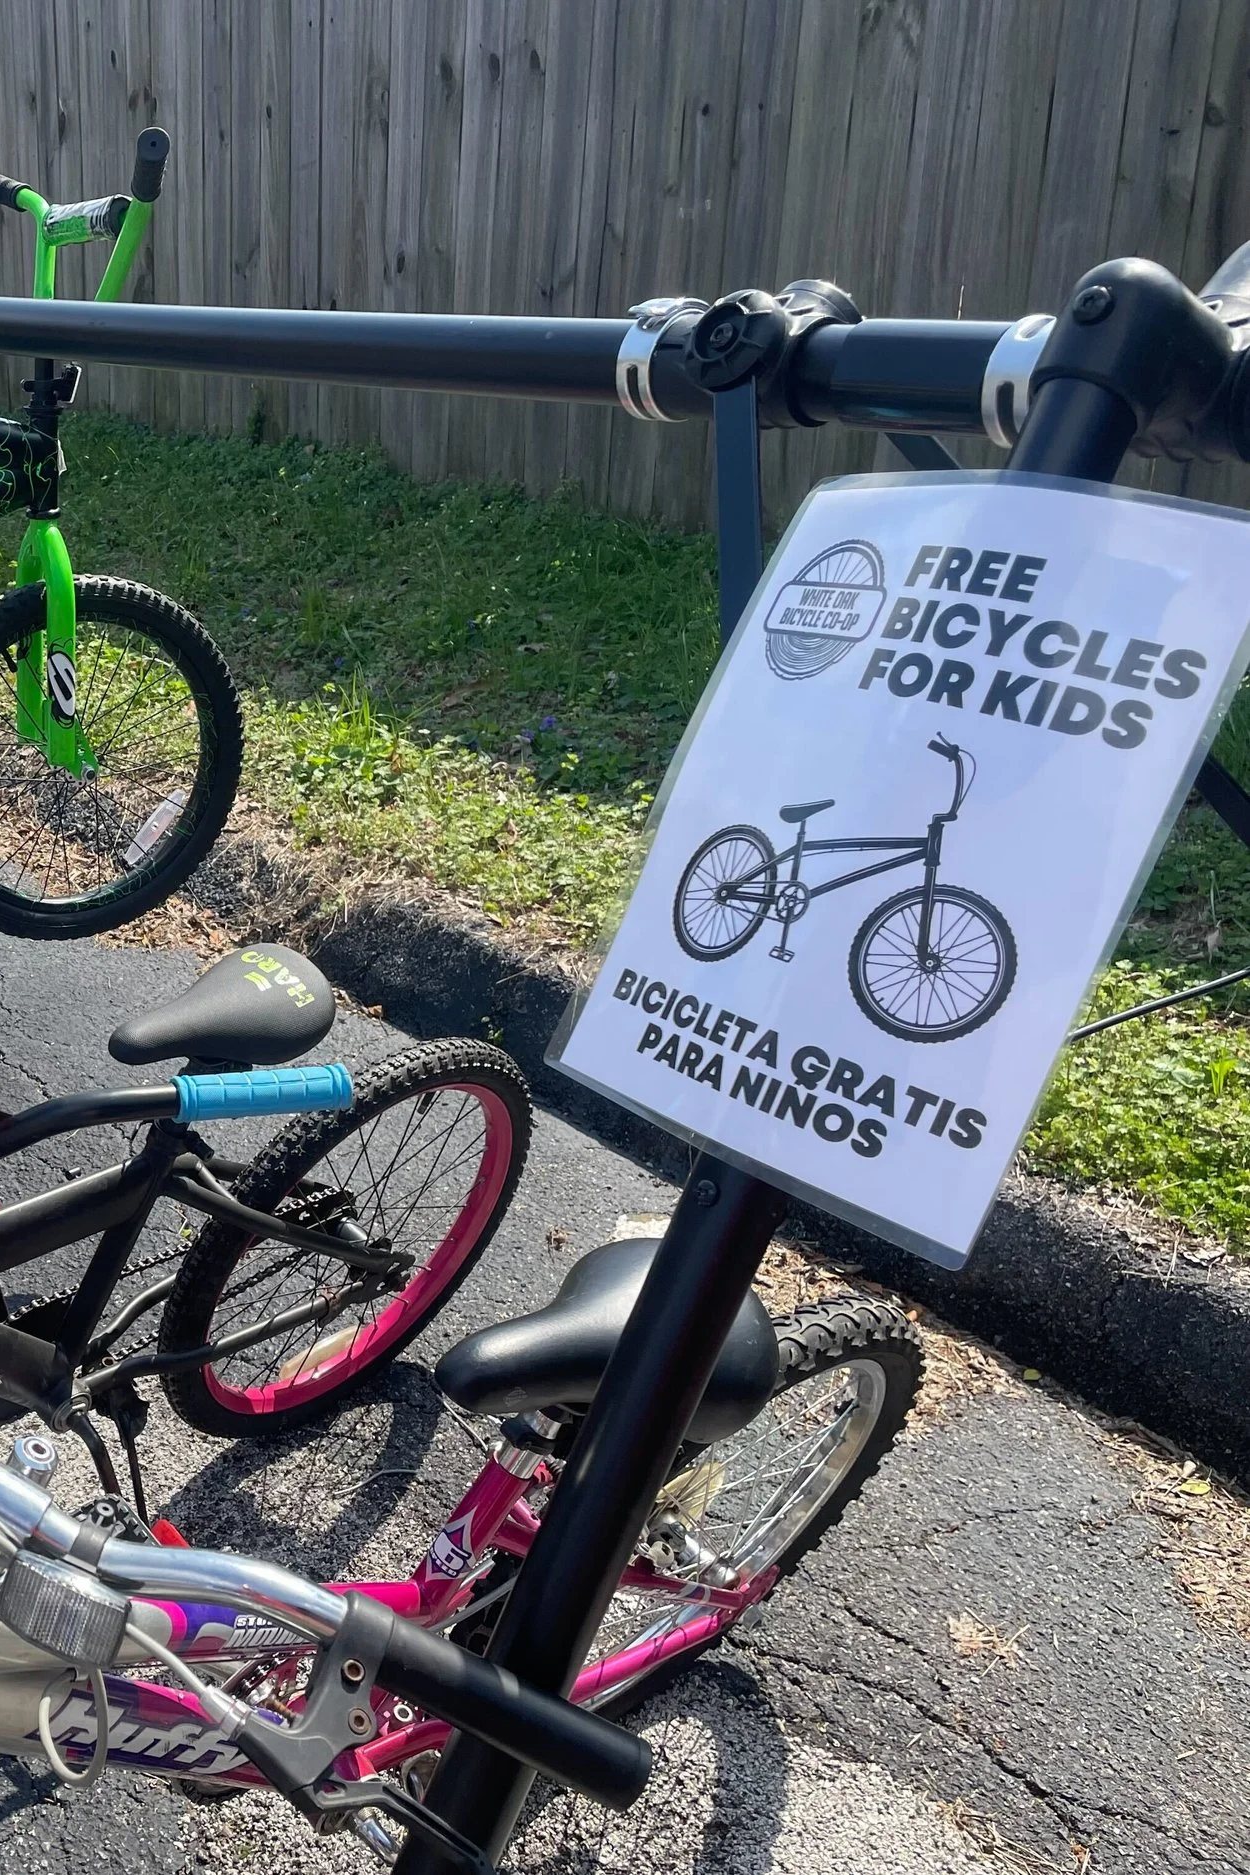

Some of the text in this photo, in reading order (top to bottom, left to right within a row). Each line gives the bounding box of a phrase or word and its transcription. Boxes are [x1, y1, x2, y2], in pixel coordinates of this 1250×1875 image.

[799, 588, 860, 610] WHITE OAK
[903, 544, 1048, 603] FREE
[779, 607, 861, 631] BICYCLE CO-OP
[880, 596, 1208, 700] BICYCLES
[858, 647, 1154, 750] FOR KIDS
[241, 950, 315, 1008] HARO
[612, 968, 988, 1149] BICICLETA GRATIS
[636, 1022, 725, 1092] PARA
[41, 1696, 250, 1775] Huffy
